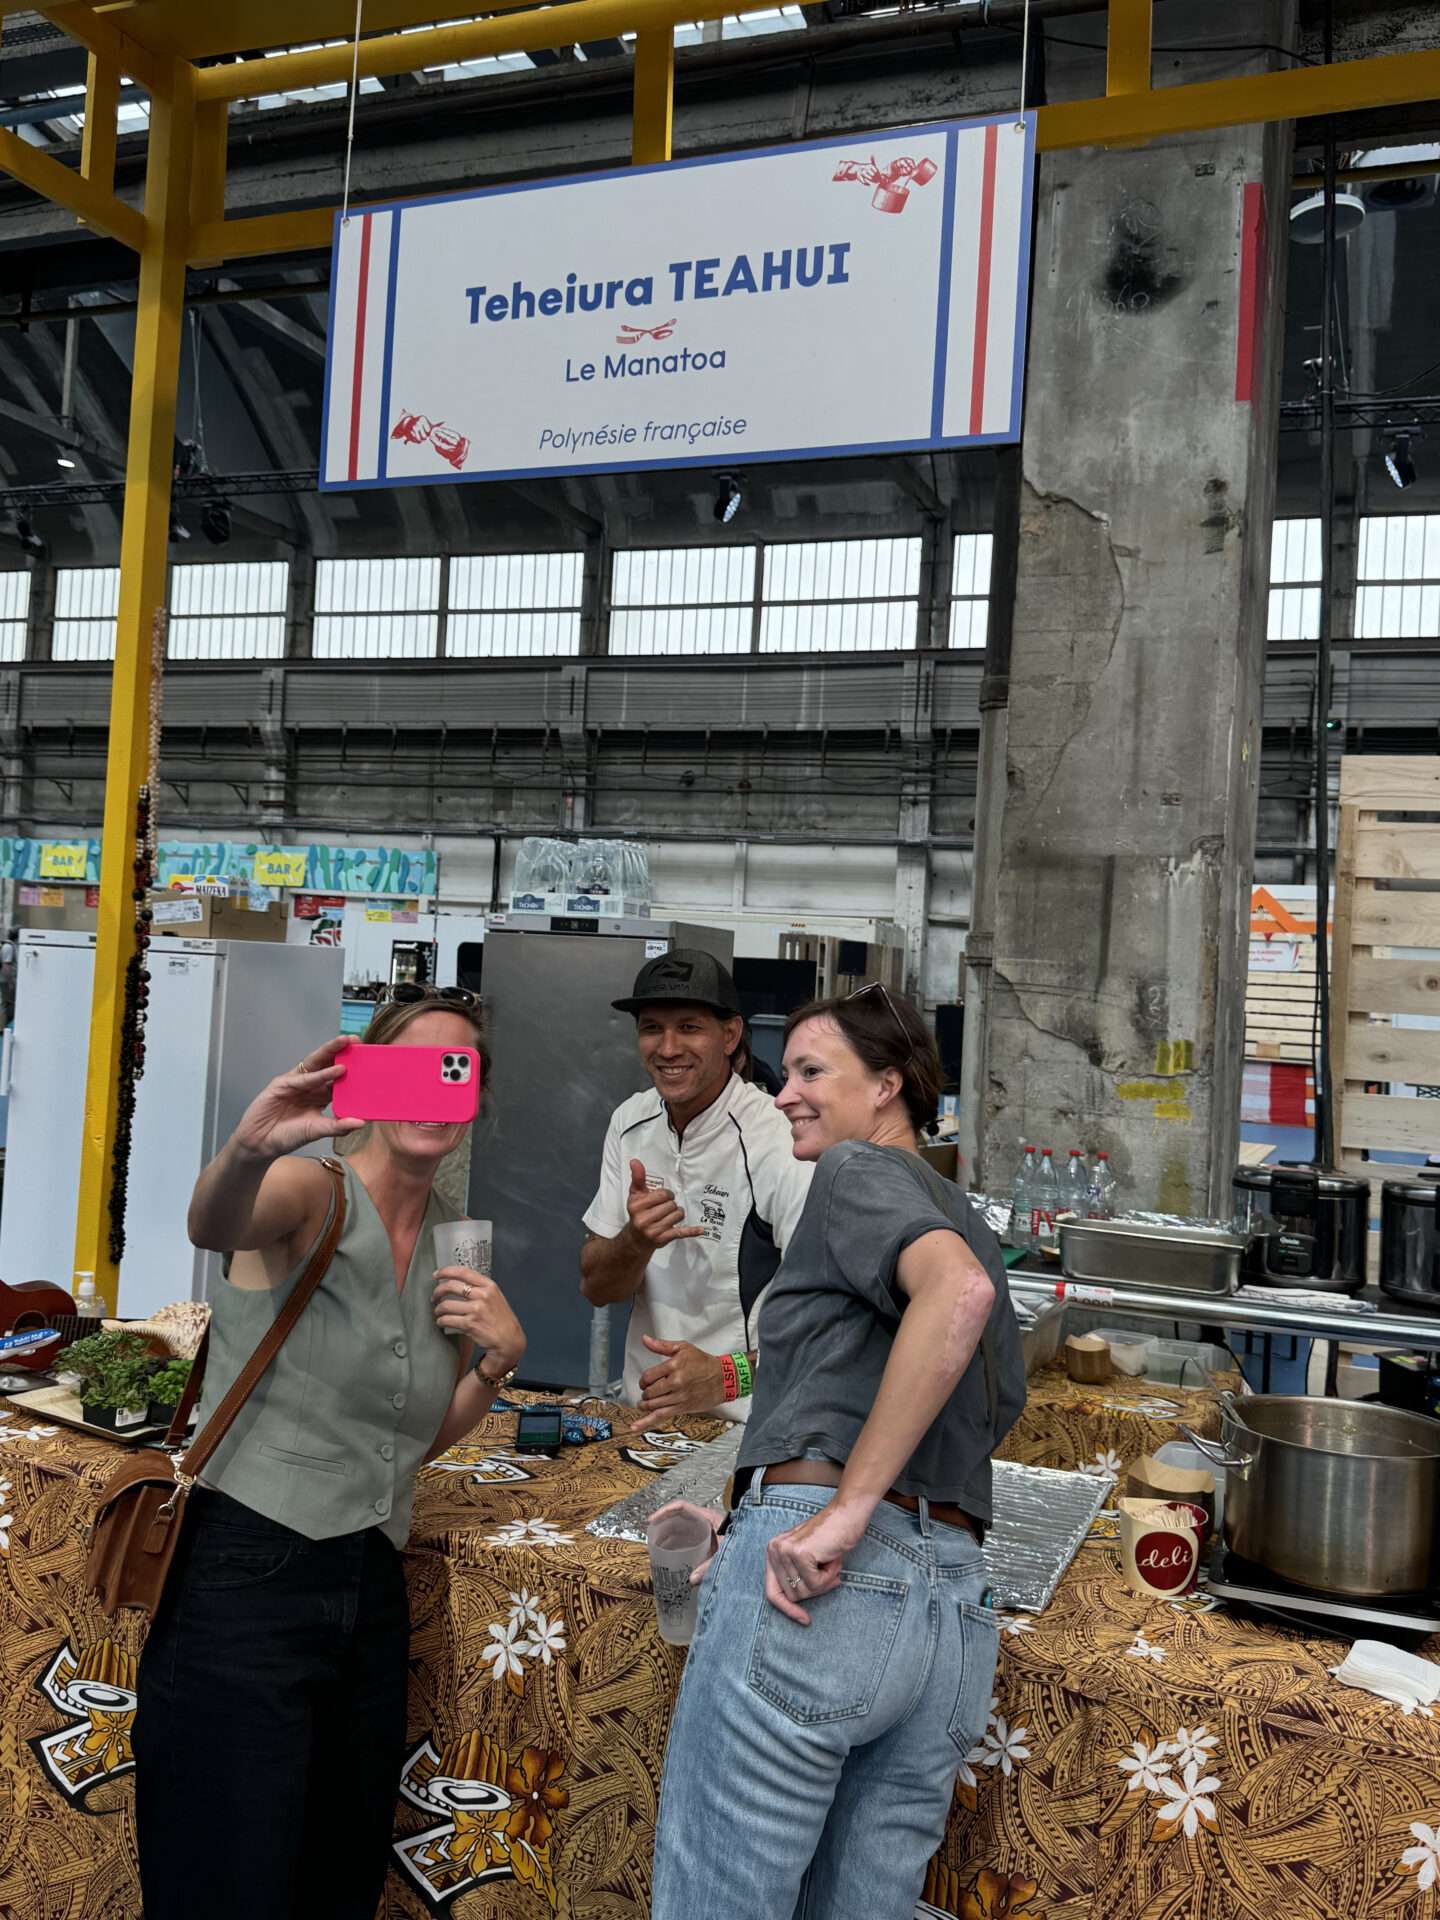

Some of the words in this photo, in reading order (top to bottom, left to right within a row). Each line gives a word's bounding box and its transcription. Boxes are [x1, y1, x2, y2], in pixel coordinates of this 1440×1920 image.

[465, 272, 654, 325] Teheiura
[669, 242, 851, 303] TEAHUI
[565, 359, 596, 382] Le
[604, 347, 727, 379] Manatoa
[539, 424, 637, 454] Polynésie
[643, 415, 748, 445] française
[52, 855, 74, 866] BAR
[267, 863, 291, 874] BAR
[1136, 1545, 1193, 1568] deli
